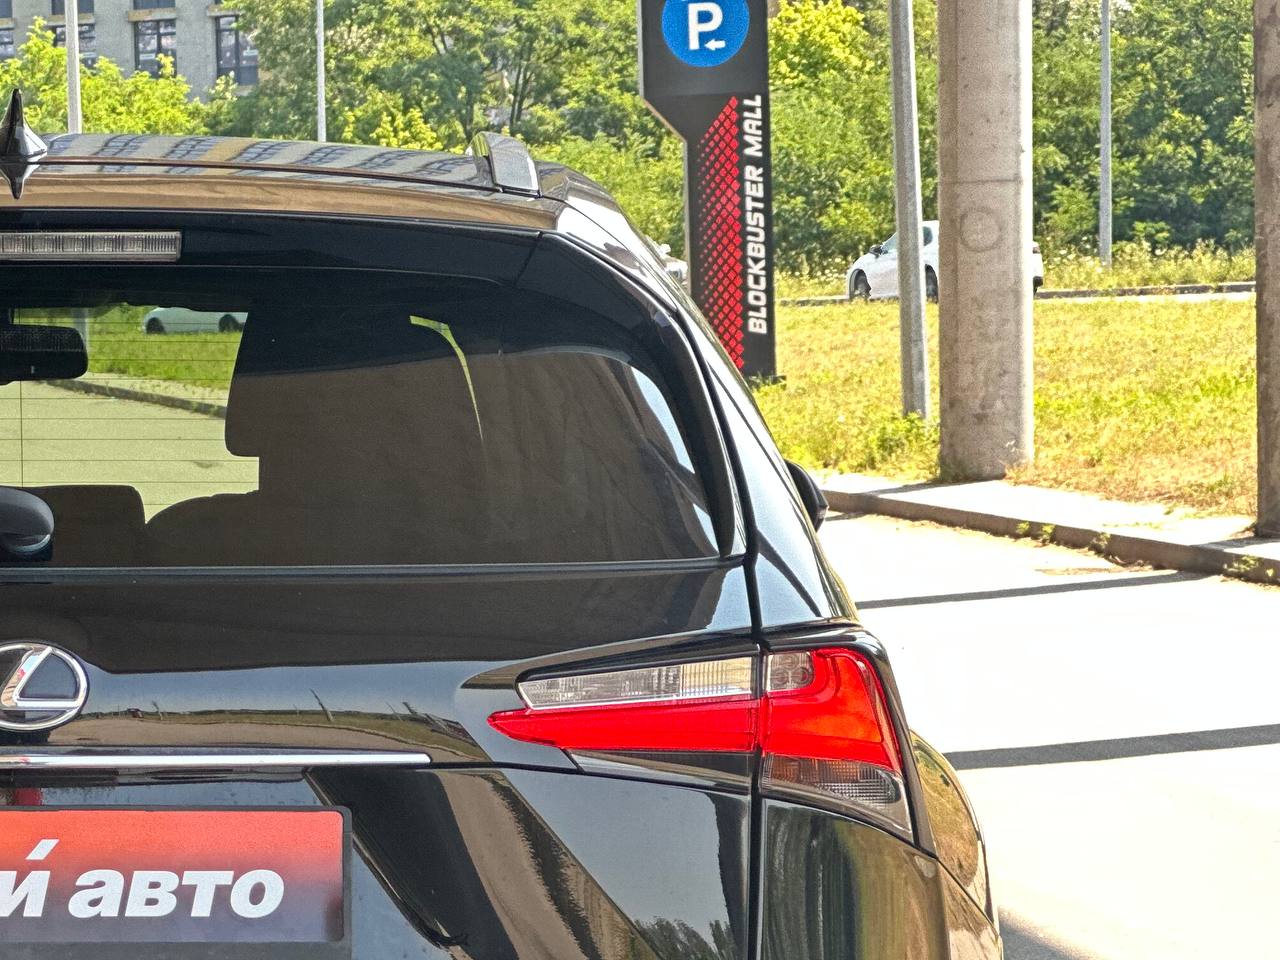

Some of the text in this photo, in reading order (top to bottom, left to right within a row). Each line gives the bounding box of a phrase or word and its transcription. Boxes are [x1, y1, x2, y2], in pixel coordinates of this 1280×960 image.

[743, 95, 767, 334] BLOCKBUSTER MALL
[67, 868, 286, 920] авто
